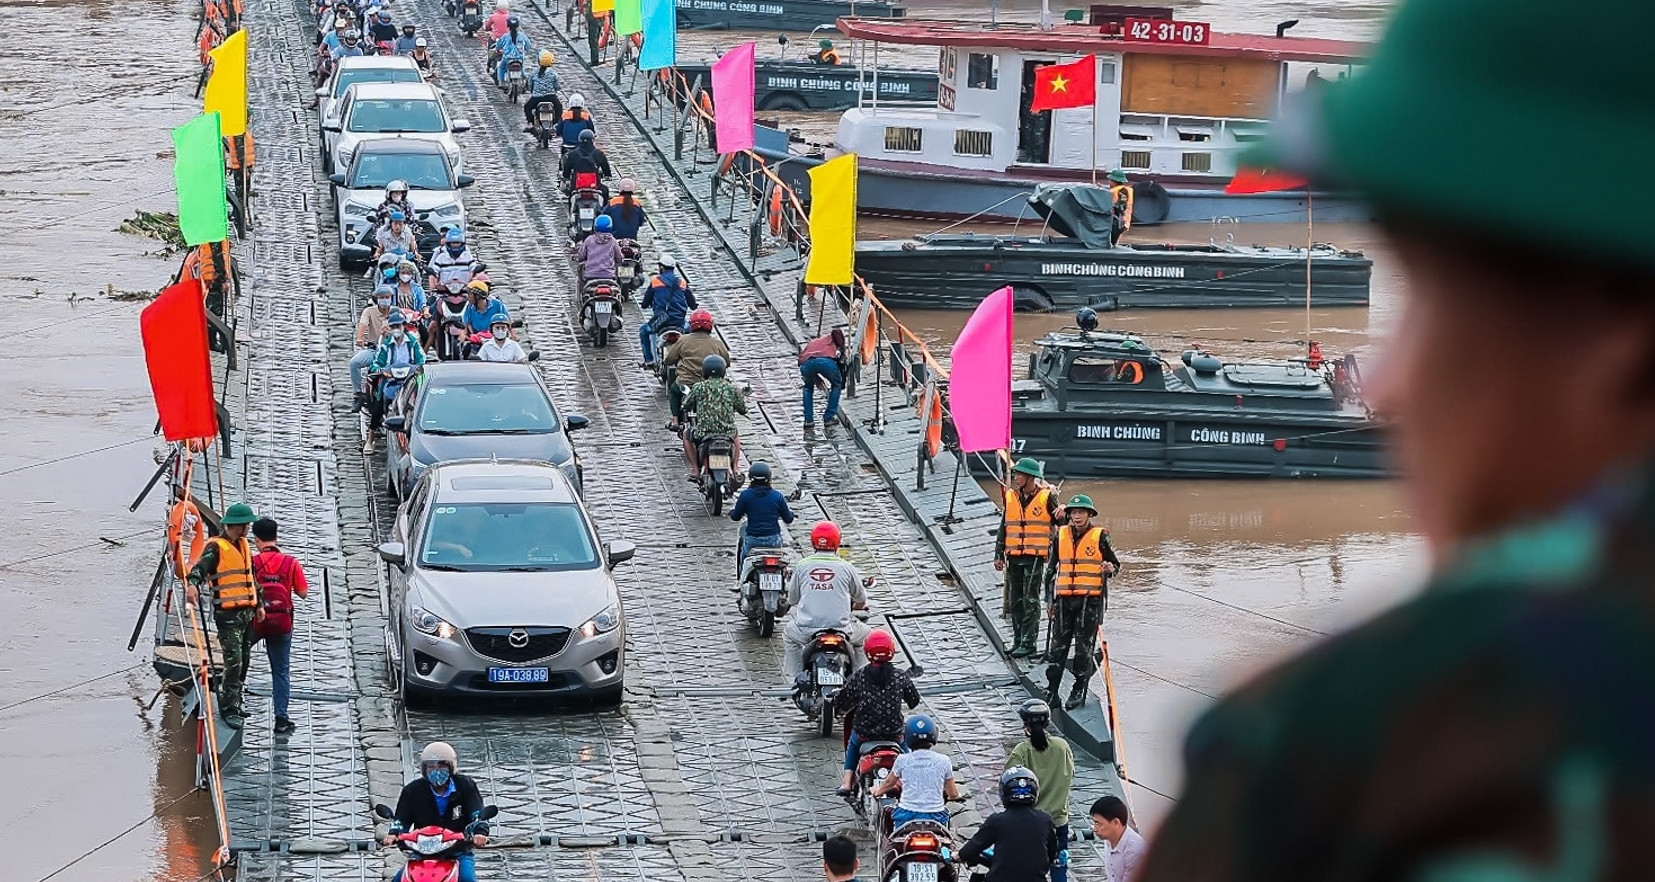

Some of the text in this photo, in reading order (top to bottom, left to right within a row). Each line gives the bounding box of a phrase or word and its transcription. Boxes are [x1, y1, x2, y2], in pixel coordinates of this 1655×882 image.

[1131, 21, 1204, 42] 42-31-03
[768, 77, 797, 88] BINH
[880, 82, 910, 94] BINH
[1077, 425, 1111, 439] BINH
[1231, 431, 1265, 446] BINH
[809, 583, 835, 591] TASA
[492, 669, 547, 682] 19A-038.89
